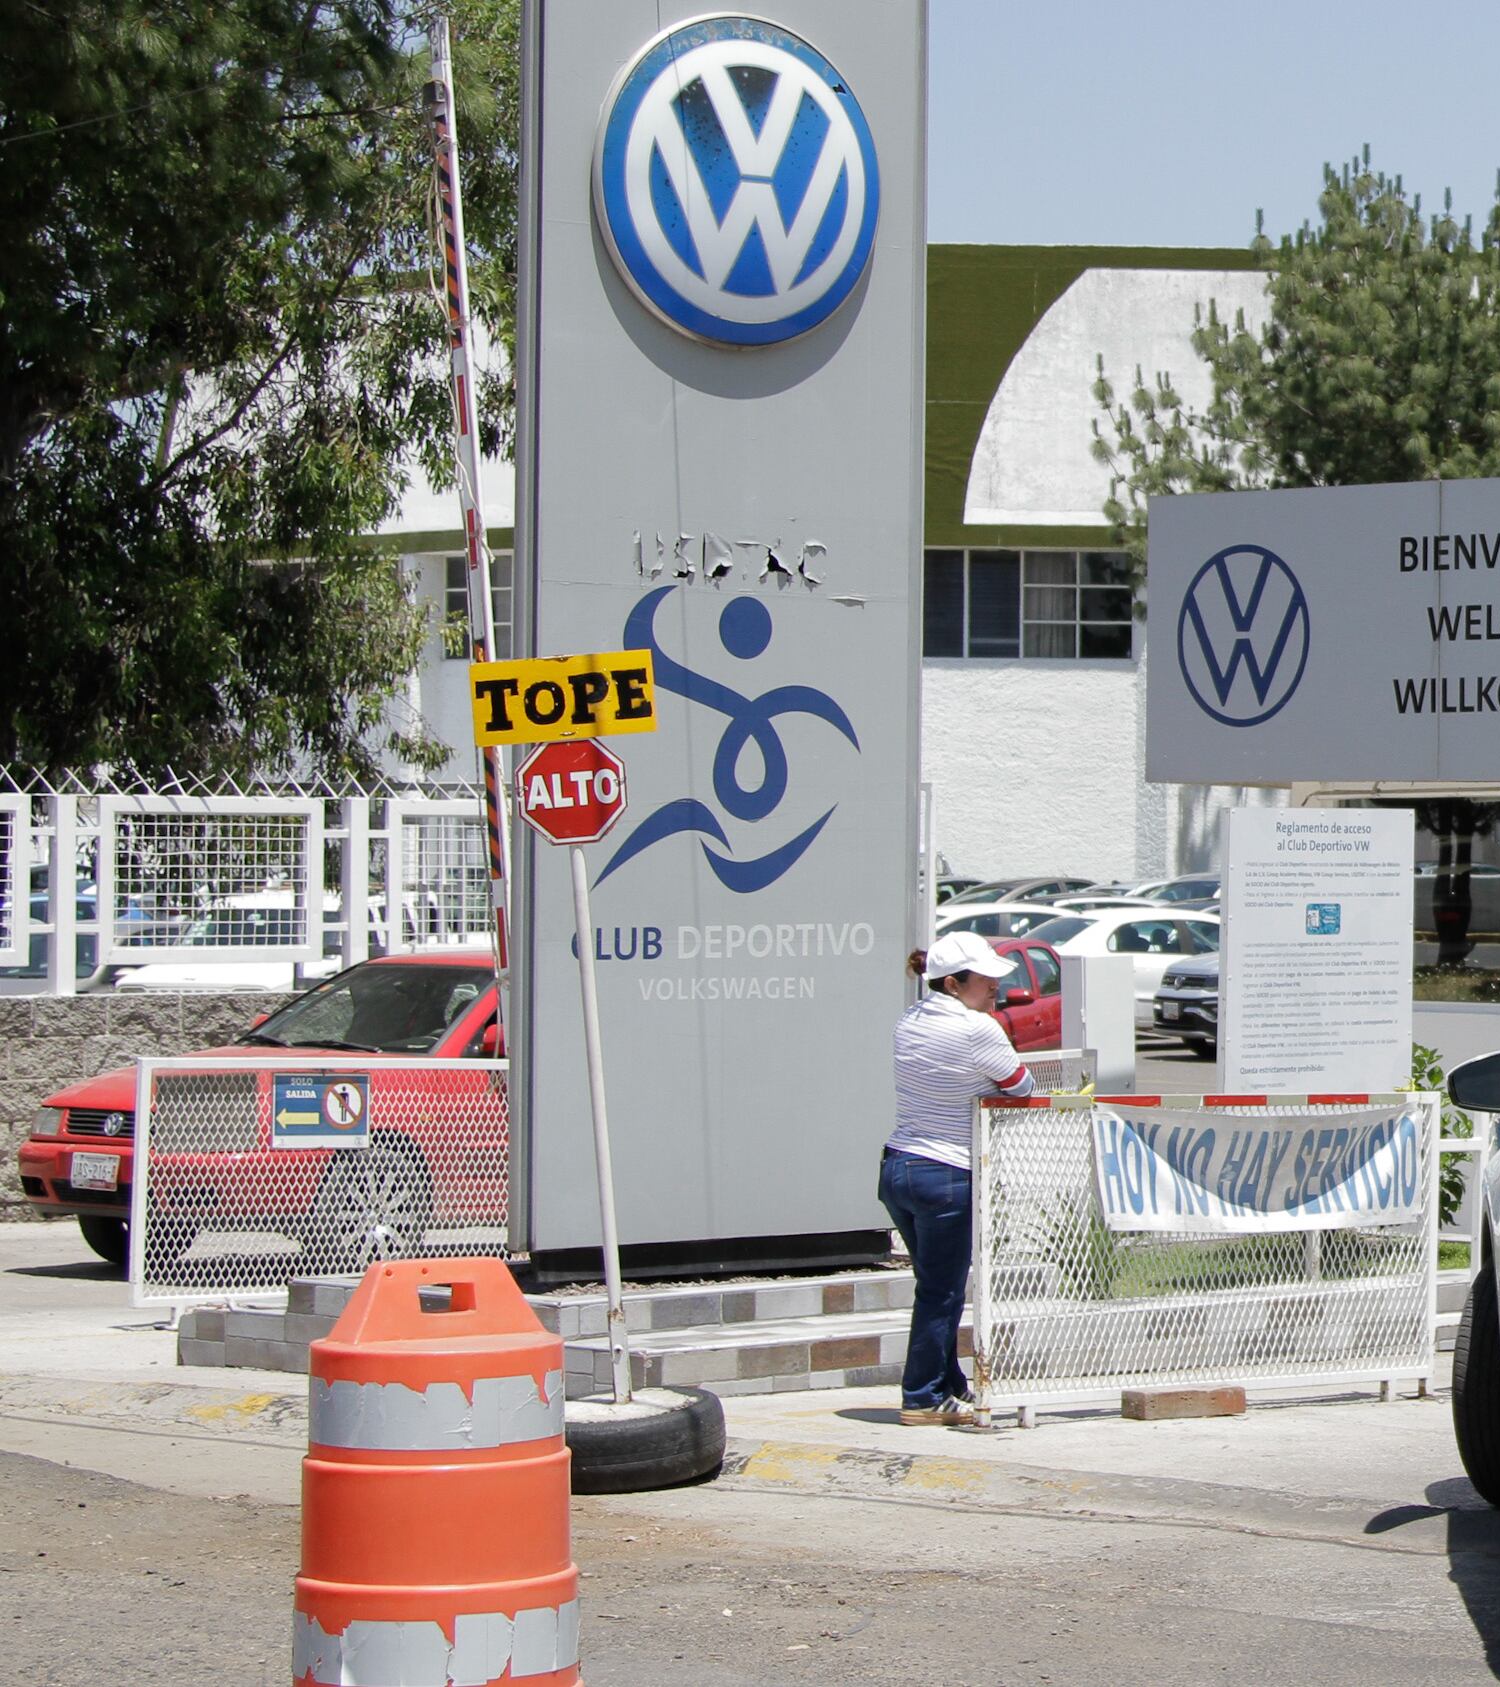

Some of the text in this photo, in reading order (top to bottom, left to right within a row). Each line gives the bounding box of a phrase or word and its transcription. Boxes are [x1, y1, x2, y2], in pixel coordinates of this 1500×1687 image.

[625, 41, 865, 323] VW
[1180, 547, 1308, 717] VW
[475, 668, 653, 732] TOPE
[527, 769, 620, 811] ALTO
[1275, 821, 1372, 836] Reglamento de acceso
[1276, 839, 1370, 854] al Club Deportivo VW
[677, 922, 875, 960] DEPORTIVO
[638, 977, 815, 1001] VOLKSWAGEN
[290, 1077, 314, 1087] SOLO
[1240, 1065, 1258, 1075] Queda
[285, 1089, 317, 1099] SALIDA
[1097, 1115, 1417, 1217] HOY NO HAY SERVICIO
